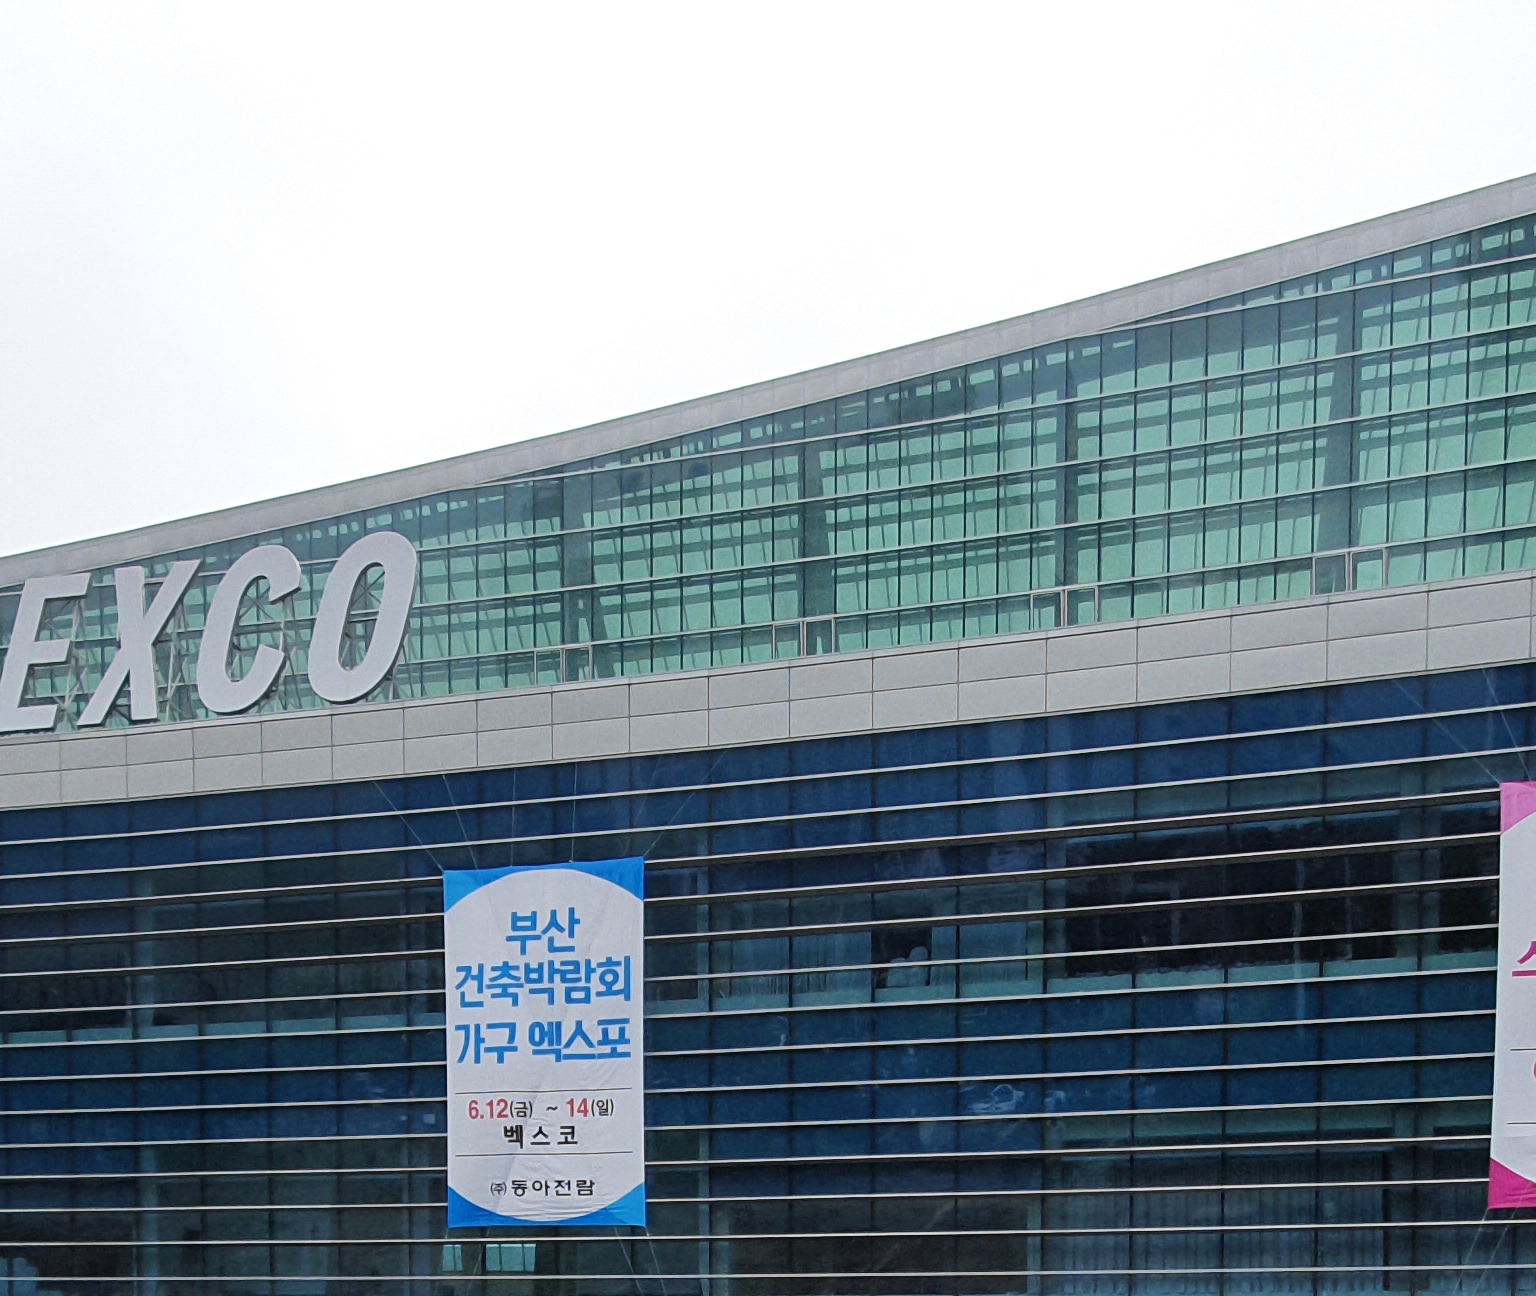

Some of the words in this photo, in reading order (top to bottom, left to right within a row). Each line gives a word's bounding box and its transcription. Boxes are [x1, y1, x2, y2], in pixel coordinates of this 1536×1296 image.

[506, 906, 580, 955] 부산
[455, 955, 632, 1008] 건축박람회
[454, 1022, 518, 1064] 가구
[528, 1017, 632, 1063] 엑스포
[467, 1098, 534, 1120] 6.12(금)
[566, 1097, 614, 1118] 14(일)
